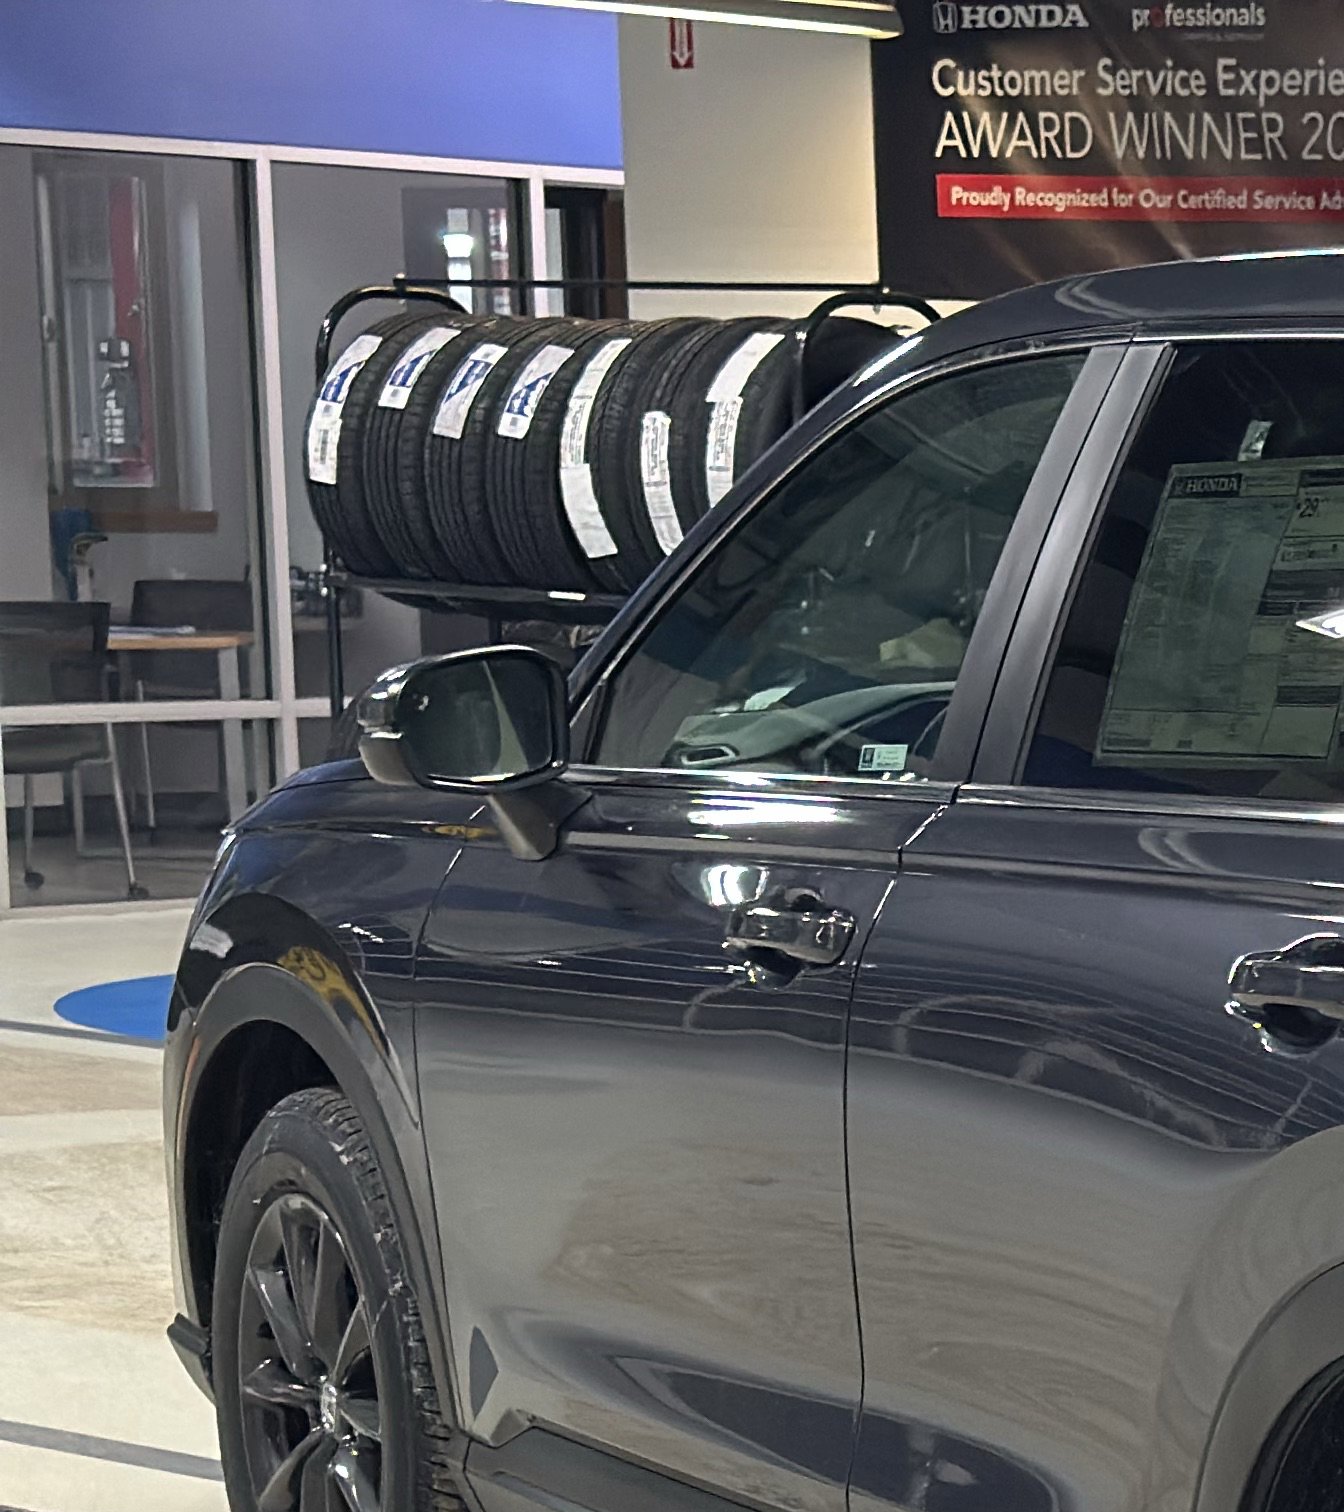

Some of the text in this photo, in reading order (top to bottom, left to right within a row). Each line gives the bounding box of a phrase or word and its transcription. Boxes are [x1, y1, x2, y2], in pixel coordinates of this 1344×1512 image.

[961, 4, 1088, 30] HONDA
[1131, 2, 1266, 32] professionals
[931, 58, 1086, 98] Customer
[1096, 58, 1207, 98] Service
[934, 111, 1093, 160] AWARD
[1108, 111, 1288, 161] WINNER
[950, 185, 1011, 212] Proudly
[1014, 186, 1109, 212] Recognized
[1112, 187, 1133, 208] for
[1138, 187, 1173, 209] Our
[1177, 188, 1248, 210] Certified
[1253, 190, 1316, 211] Service
[1184, 476, 1238, 494] HONDA
